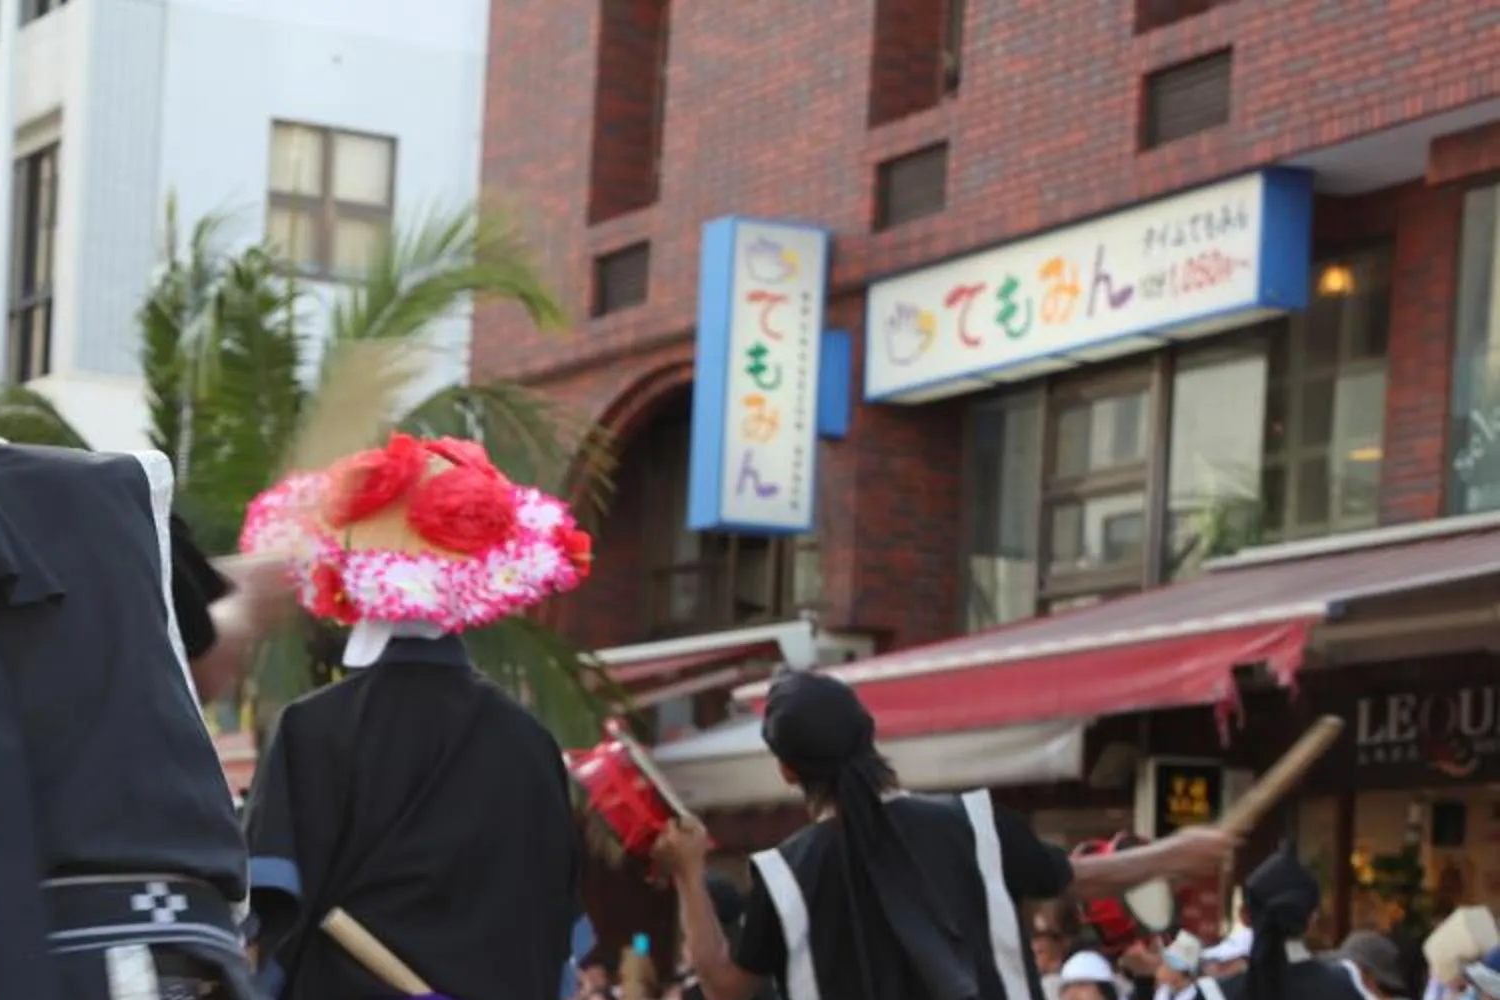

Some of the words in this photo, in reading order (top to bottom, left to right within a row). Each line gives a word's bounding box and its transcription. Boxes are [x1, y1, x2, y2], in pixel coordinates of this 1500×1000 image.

[943, 243, 1134, 346] てもみん
[735, 289, 788, 498] てもみん
[1356, 686, 1500, 745] LEQU
